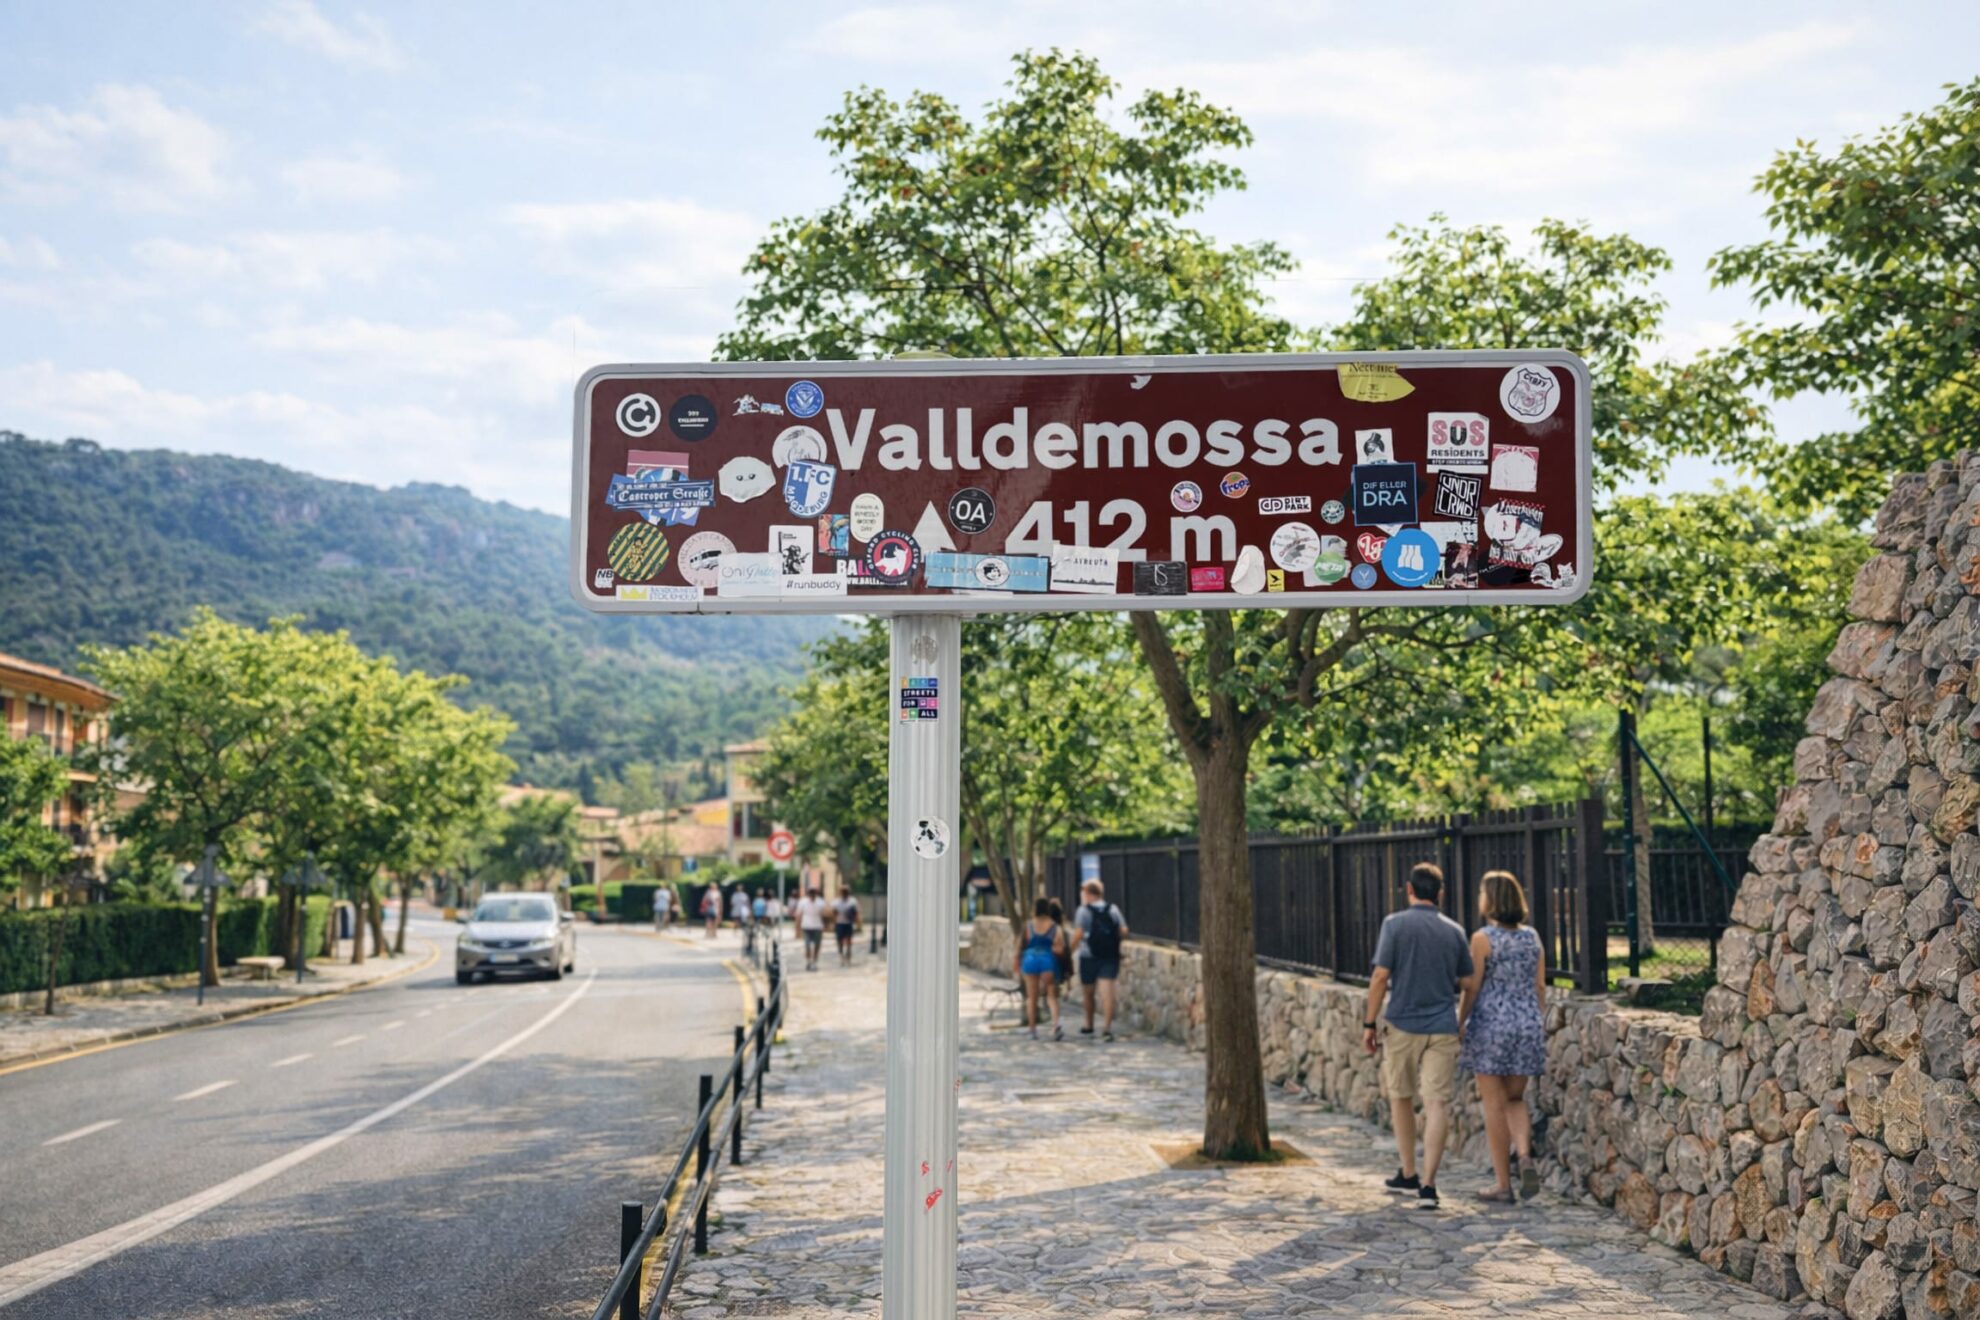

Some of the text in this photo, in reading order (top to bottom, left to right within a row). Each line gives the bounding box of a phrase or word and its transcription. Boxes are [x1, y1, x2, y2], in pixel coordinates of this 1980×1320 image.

[826, 406, 1343, 470] Valldemossa
[1432, 420, 1485, 446] SOS
[786, 485, 828, 514] MAGDEBURG
[1363, 490, 1408, 507] DRA
[1438, 487, 1474, 517] CRWD
[1442, 476, 1477, 507] UNDR
[955, 499, 987, 524] OA
[1004, 498, 1237, 562] 412 m
[786, 580, 841, 590] #runbuddy
